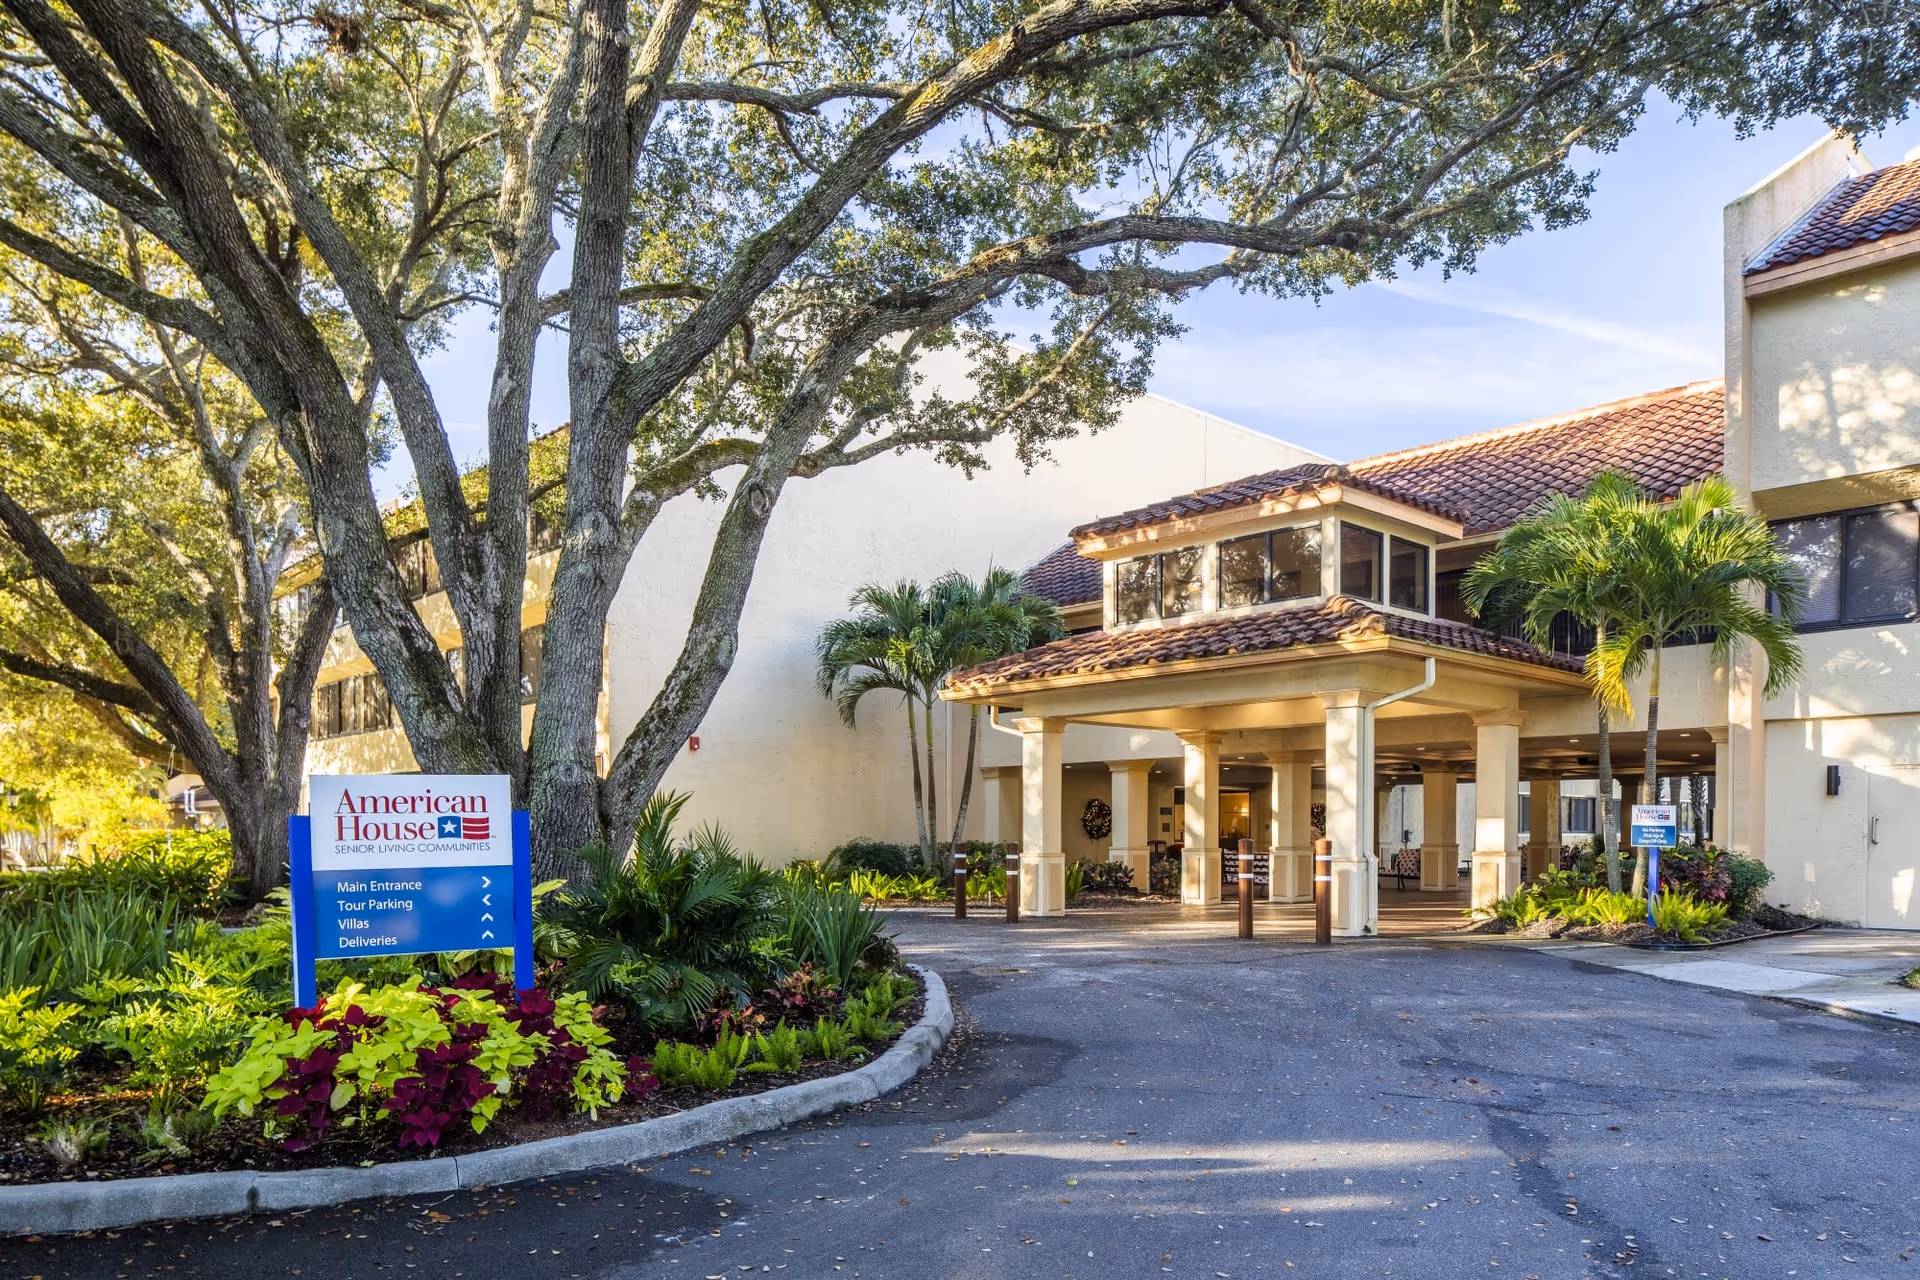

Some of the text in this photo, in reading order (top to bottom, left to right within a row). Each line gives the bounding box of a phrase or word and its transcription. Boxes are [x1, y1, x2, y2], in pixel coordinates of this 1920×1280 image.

[334, 788, 489, 814] American
[334, 815, 435, 841] House
[335, 842, 490, 855] SENIOR LIVING COMMUNITIES
[338, 881, 422, 892] Main Entrance
[337, 899, 413, 911] Tour Parking
[338, 918, 369, 930] Villas
[339, 935, 397, 948] Deliveries
